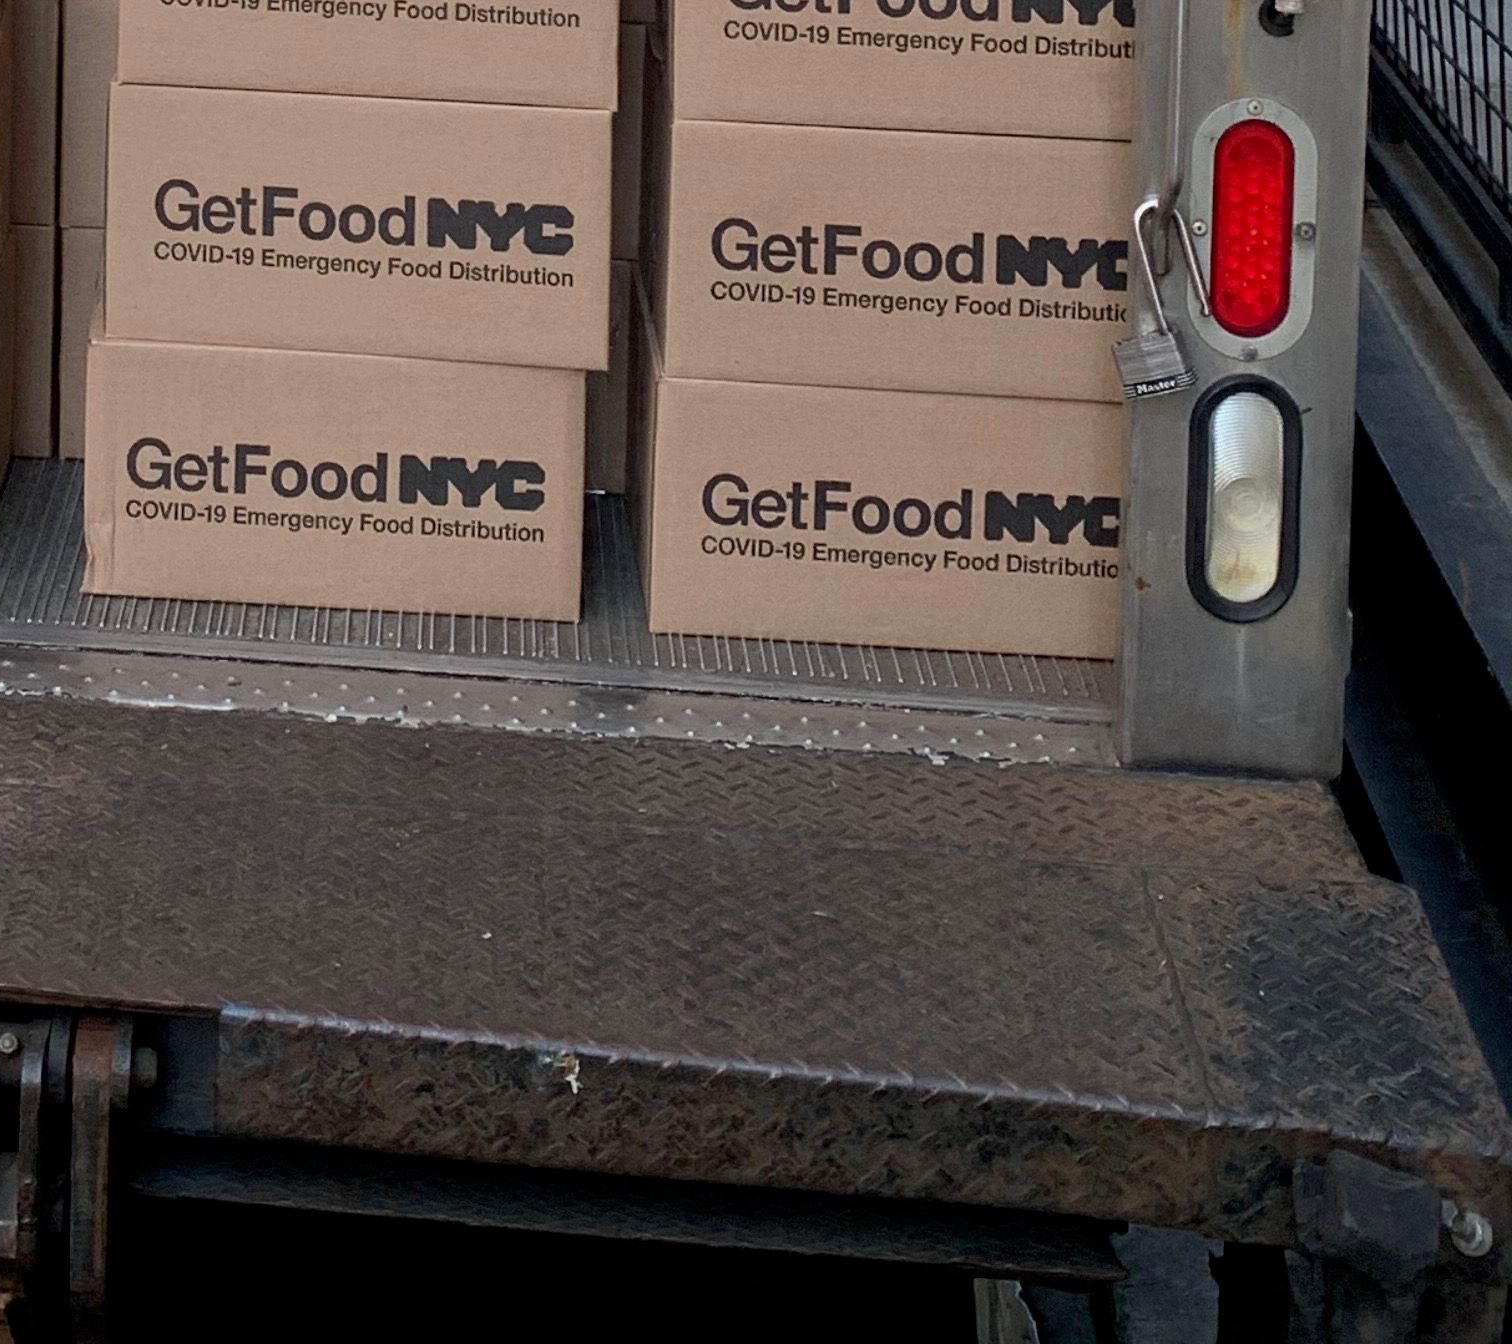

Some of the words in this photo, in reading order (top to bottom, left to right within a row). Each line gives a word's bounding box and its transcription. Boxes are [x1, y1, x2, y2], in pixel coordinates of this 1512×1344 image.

[154, 241, 254, 266] COVID-19
[262, 248, 382, 278] Emergency
[388, 257, 442, 279] Food
[450, 261, 574, 287] Distribution
[701, 535, 805, 560] COVID-19
[813, 542, 937, 572] Emergency
[943, 550, 999, 572] Food
[1007, 554, 1118, 579] Distributio
